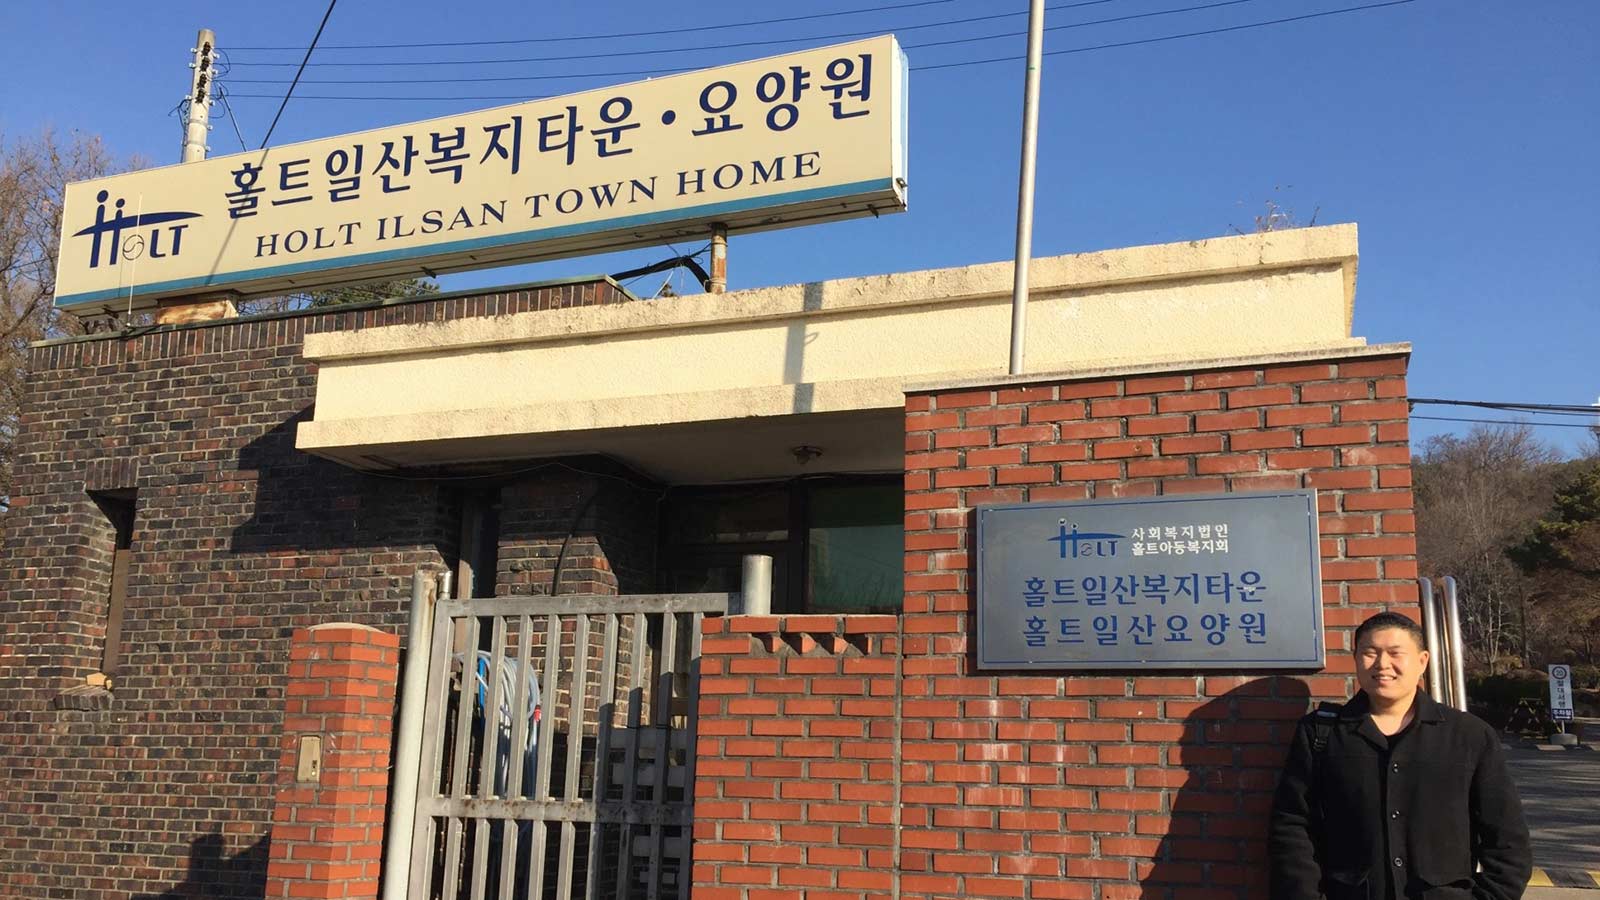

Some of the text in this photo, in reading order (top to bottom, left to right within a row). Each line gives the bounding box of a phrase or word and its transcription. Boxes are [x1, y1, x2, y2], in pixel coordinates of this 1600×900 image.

[254, 151, 821, 258] HOLT ILSAN TOWN HOME
[1131, 524, 1228, 541] 사회복지법인
[1131, 539, 1229, 556] 홀트아동복지회
[1022, 570, 1266, 608] 홀트일산복지타운
[1022, 613, 1267, 647] 홀트일산요양원
